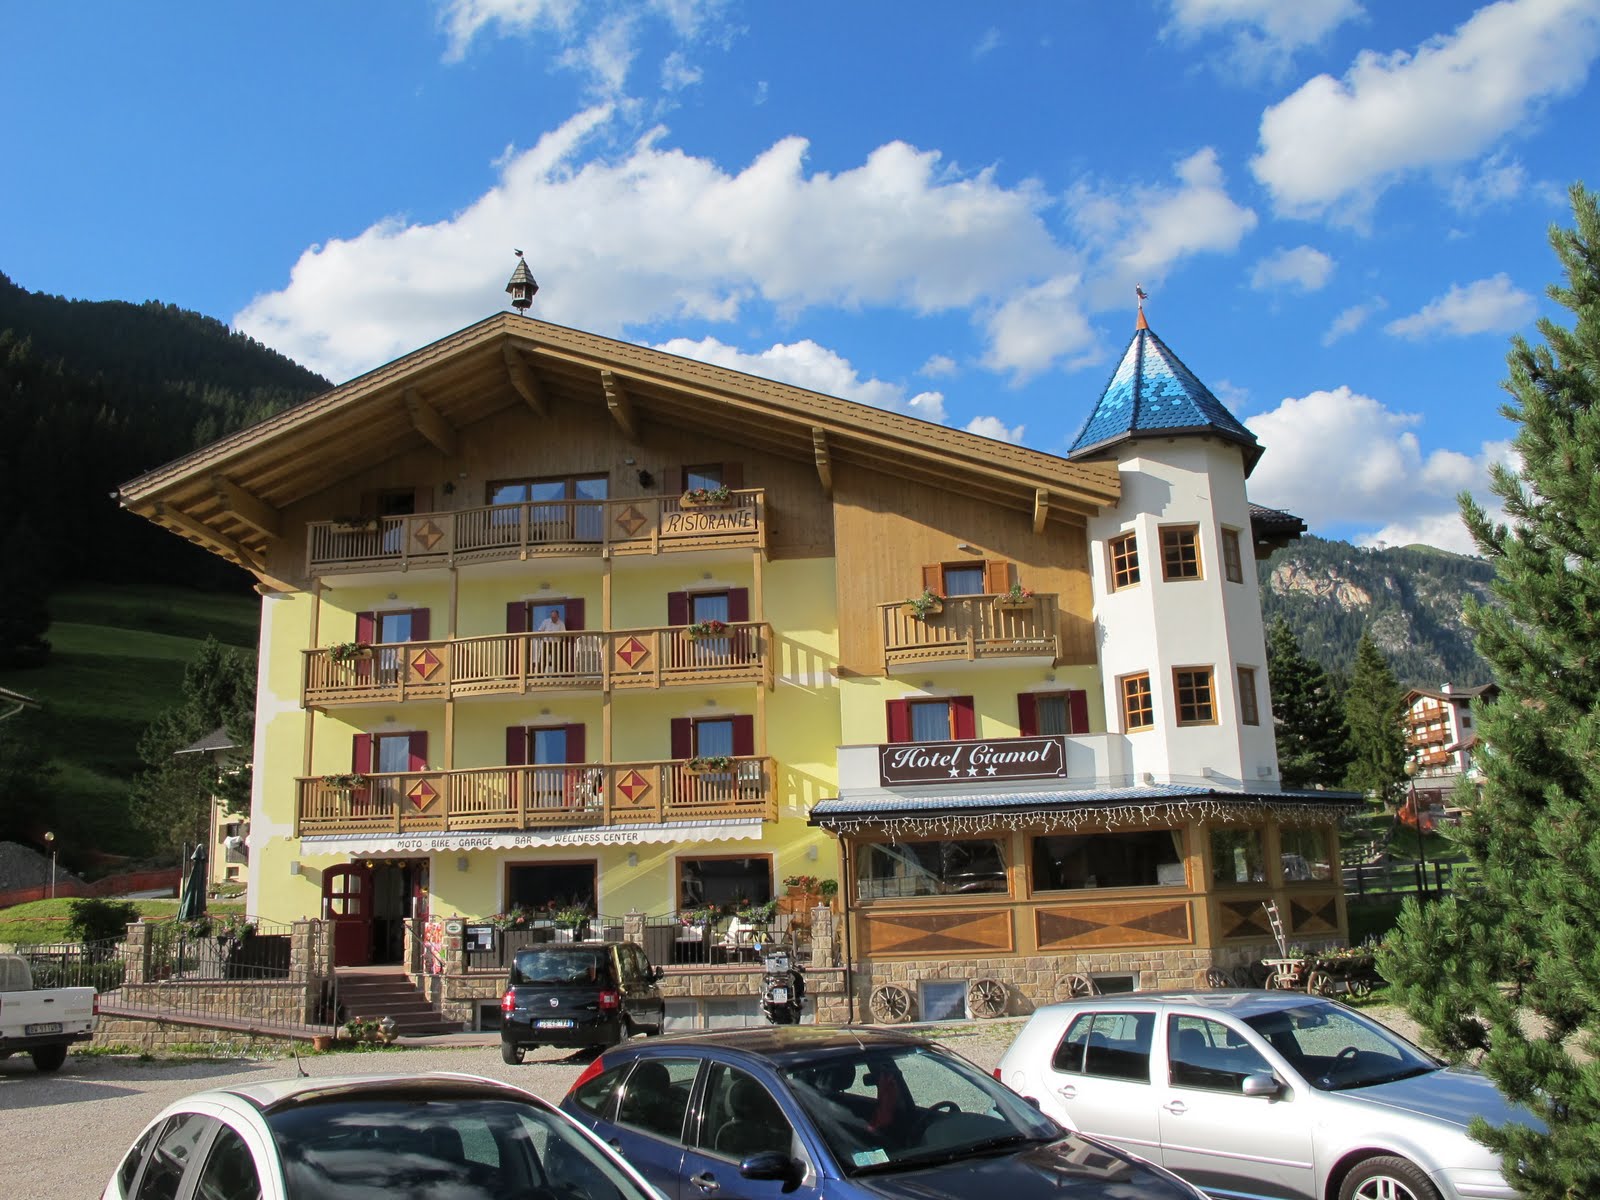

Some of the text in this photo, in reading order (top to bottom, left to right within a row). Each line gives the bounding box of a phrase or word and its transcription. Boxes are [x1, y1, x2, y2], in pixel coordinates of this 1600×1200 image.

[666, 509, 752, 532] RISTORANTE
[891, 741, 1053, 769] Hotel Ciamol
[397, 839, 422, 848] MOTO
[431, 839, 450, 848] BIKE
[458, 837, 493, 847] GARAGE
[514, 836, 532, 845] BAR
[554, 833, 601, 843] WELLNESS
[603, 832, 638, 841] CENTER
